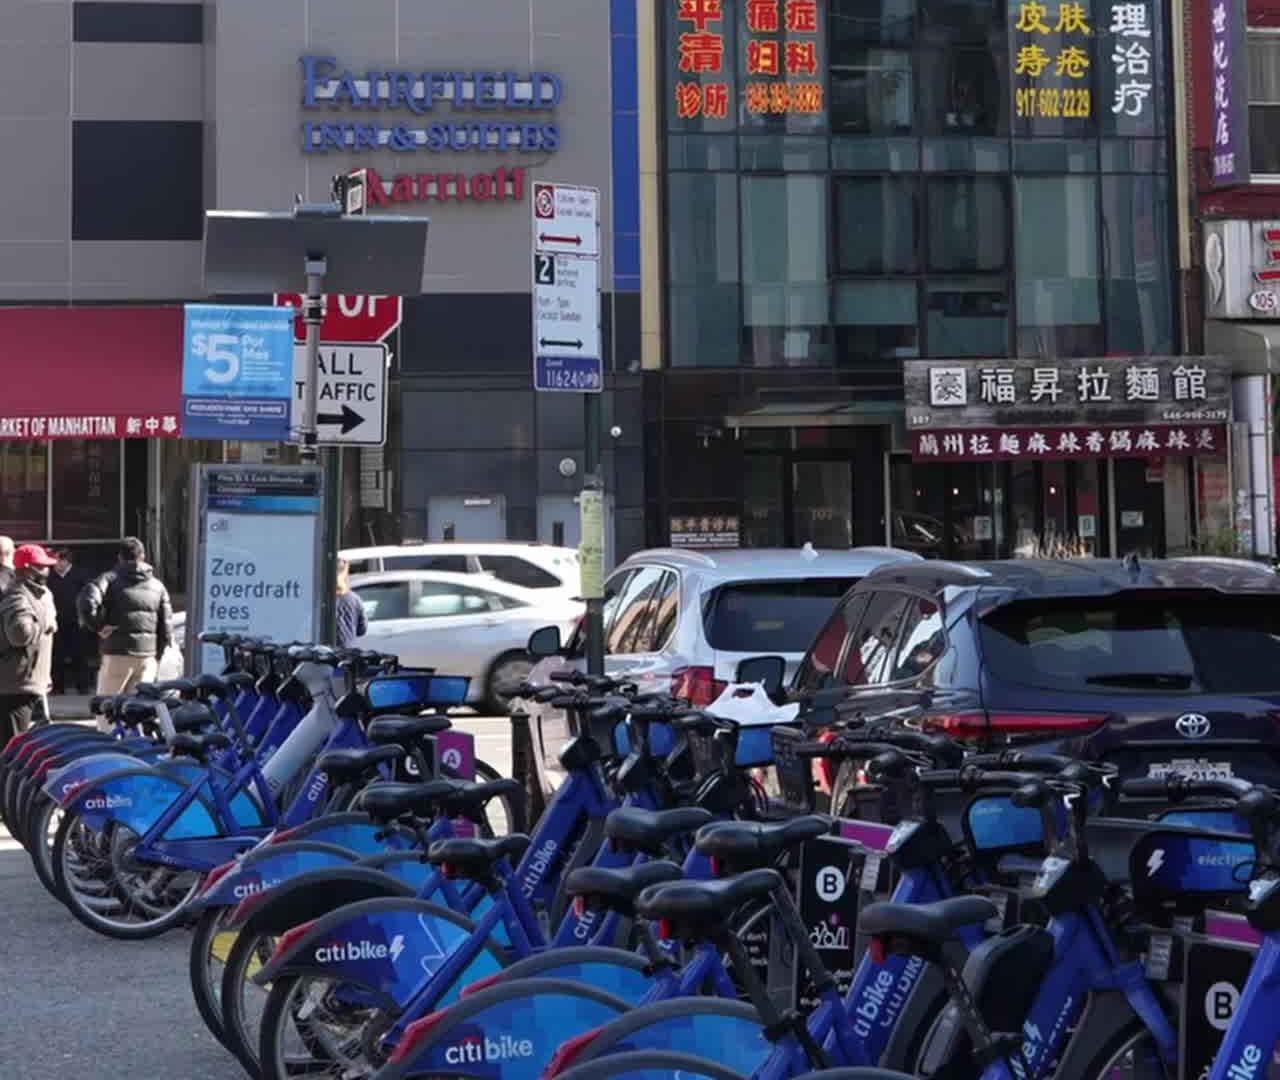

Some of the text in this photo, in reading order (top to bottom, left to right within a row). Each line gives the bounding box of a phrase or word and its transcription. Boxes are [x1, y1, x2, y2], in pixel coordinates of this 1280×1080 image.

[1015, 1, 1091, 35] 皮肤
[747, 40, 817, 75] 妇科
[1015, 44, 1090, 78] 痔疮
[299, 55, 562, 115] FAIRFIELD
[304, 122, 560, 152] INN & SUITES
[539, 256, 551, 282] 2
[1254, 293, 1275, 310] 105
[296, 381, 376, 401] TAFFIC
[31, 418, 46, 436] OF
[48, 415, 116, 435] MANHATTAN
[211, 558, 256, 577] Zero
[210, 580, 301, 599] overdraft
[209, 602, 250, 620] fees
[534, 839, 558, 873] bike
[573, 910, 597, 939] citi
[315, 938, 388, 962] citi bike
[863, 969, 894, 1015] bike
[445, 1035, 535, 1066] citi bike
[1226, 1043, 1262, 1080] ike
